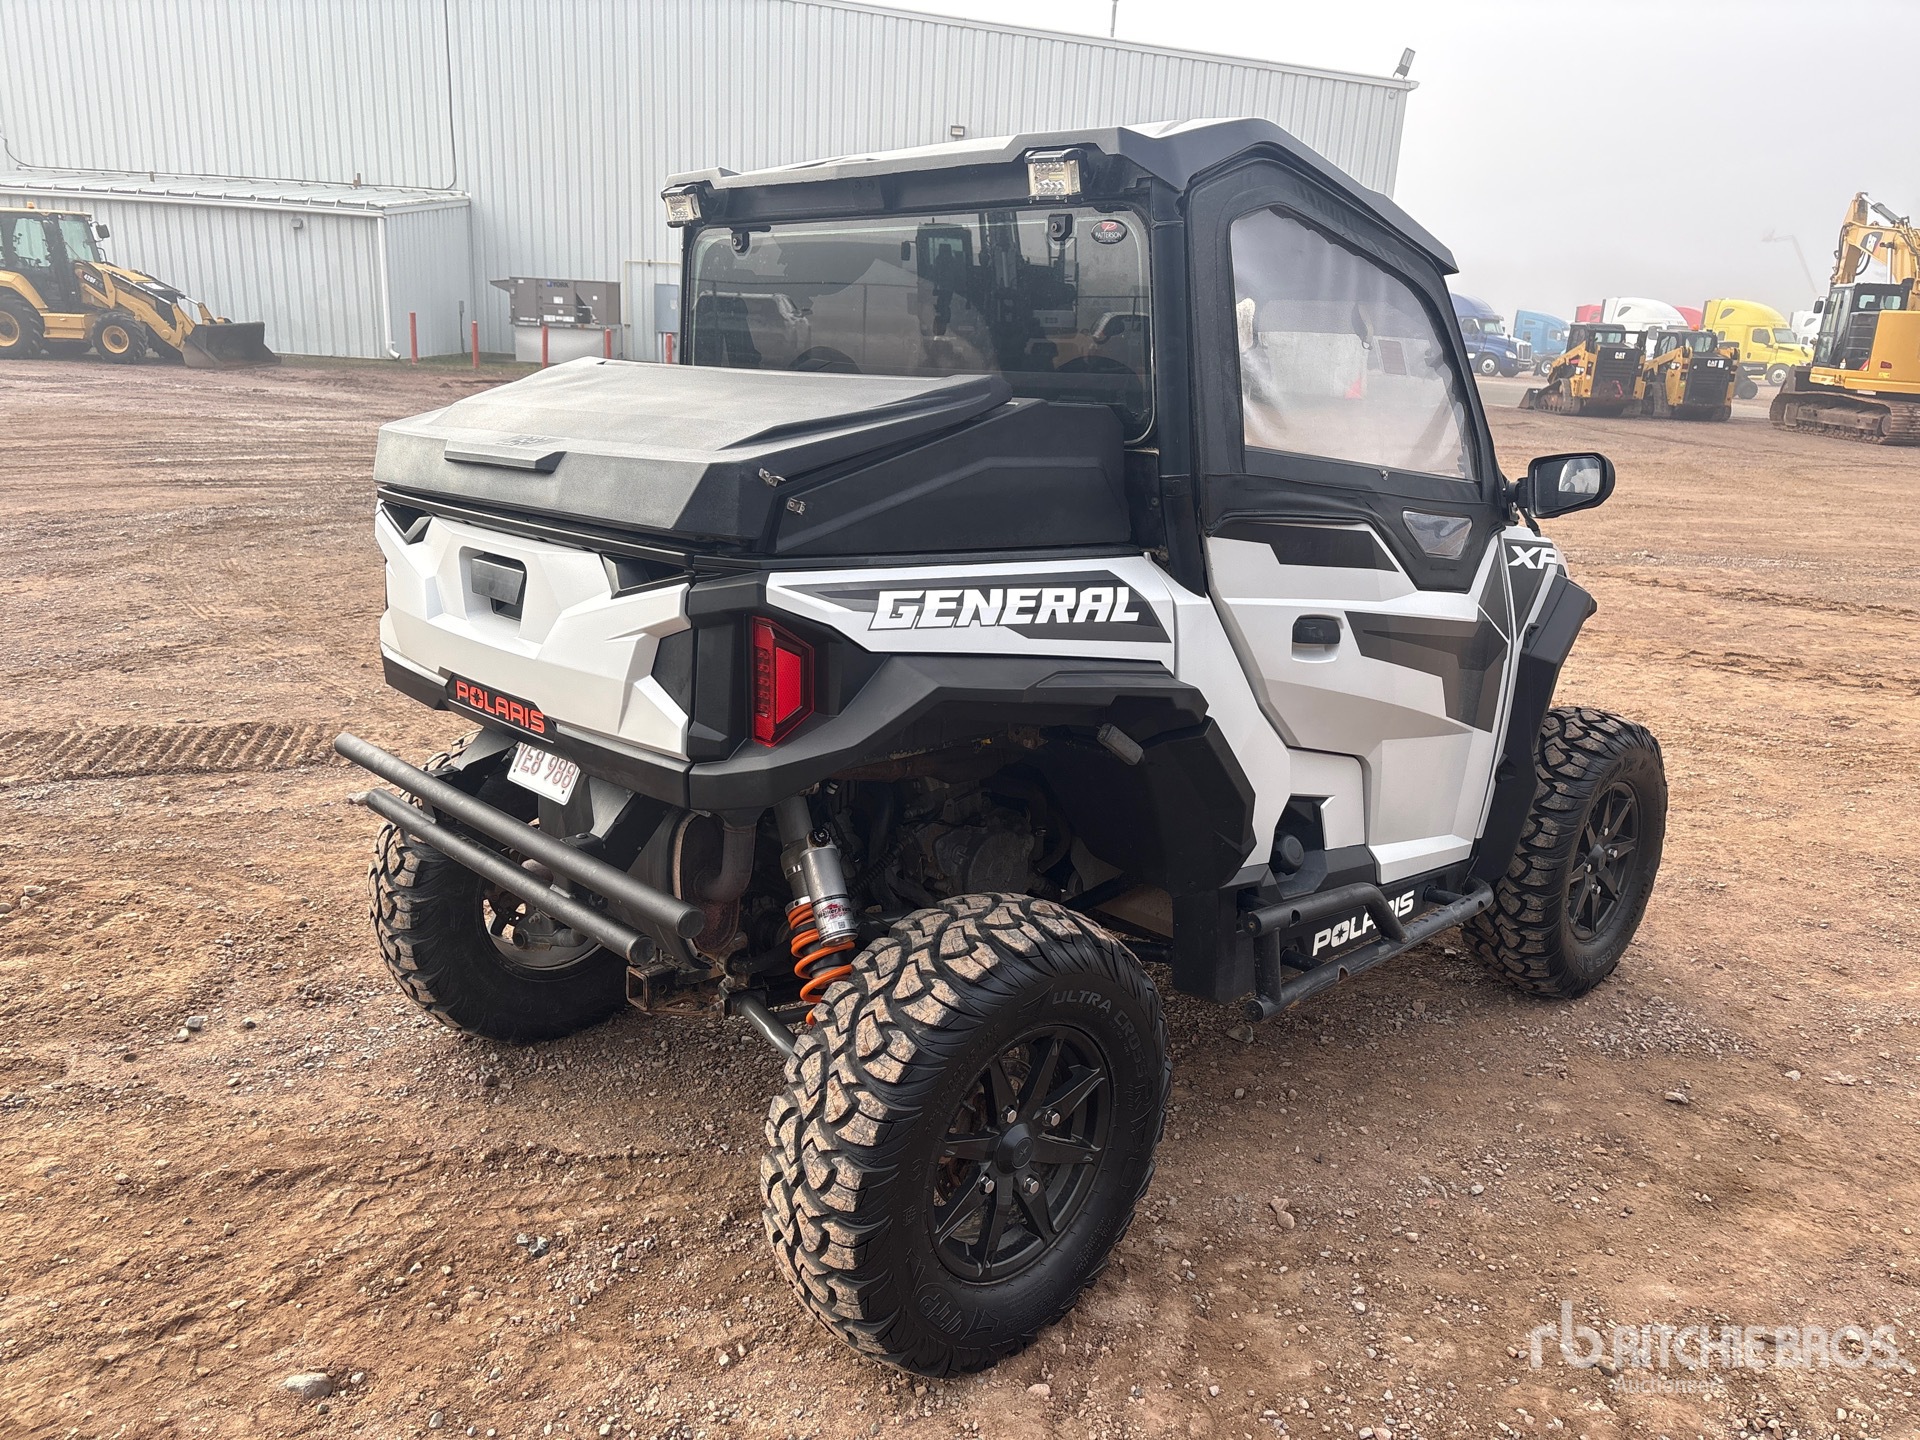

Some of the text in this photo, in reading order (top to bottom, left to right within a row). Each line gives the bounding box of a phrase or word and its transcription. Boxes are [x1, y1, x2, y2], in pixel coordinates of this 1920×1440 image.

[1095, 231, 1122, 239] PATTERSON
[1866, 234, 1877, 253] CAT
[1614, 351, 1626, 359] CAT
[869, 586, 1140, 630] GENERAL
[456, 680, 545, 734] POLARIS
[544, 756, 576, 789] 988
[1052, 989, 1112, 1014] ULTRA
[1113, 1009, 1149, 1078] CROSS
